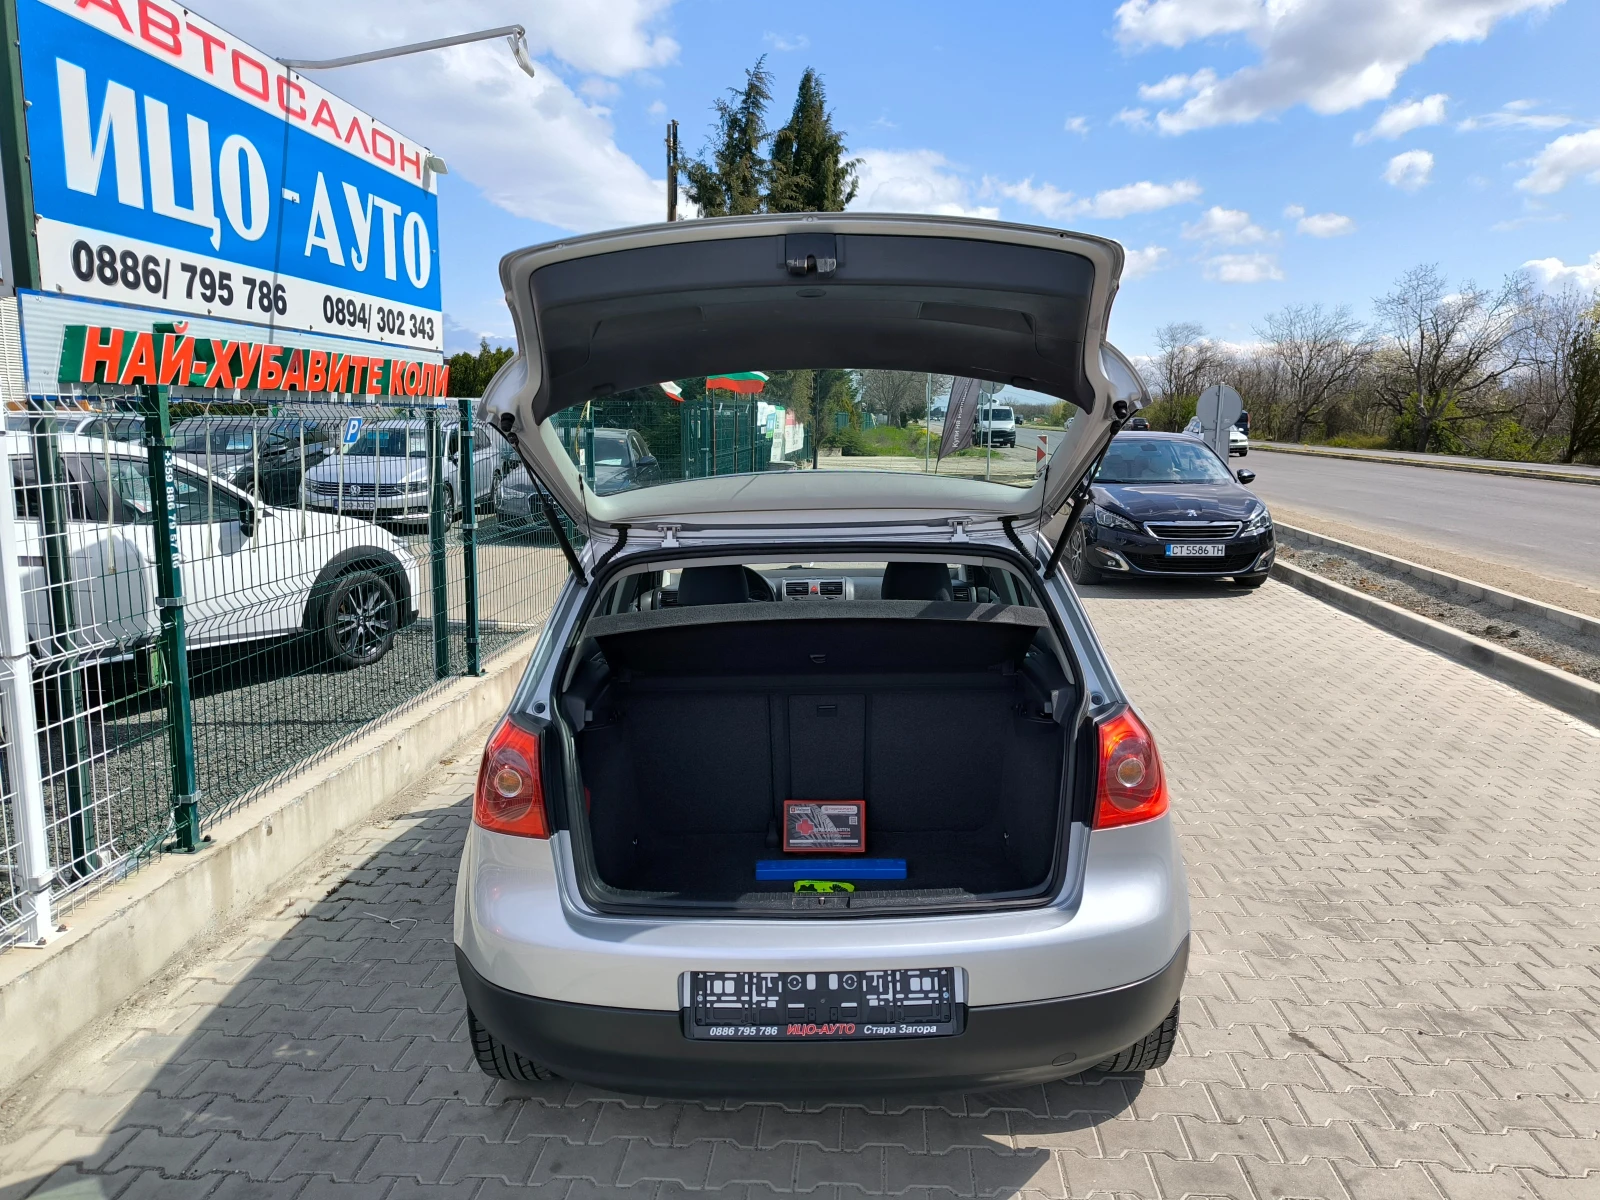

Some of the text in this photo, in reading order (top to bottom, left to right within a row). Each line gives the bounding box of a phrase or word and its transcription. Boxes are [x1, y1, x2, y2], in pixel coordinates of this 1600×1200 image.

[74, 0, 422, 180] АВТОСАЛОН
[55, 56, 432, 290] ИЦО-АУТО
[70, 239, 435, 341] 0886/ 795 786 0894/ 302 343
[79, 320, 450, 398] НАЙ-ХУБАВИТЕ КОЛИ
[164, 450, 174, 482] +359
[166, 486, 176, 511] 886
[168, 512, 177, 530] 79
[1172, 545, 1224, 555] CT 5586 TH
[709, 1023, 937, 1036] 0886 795 786 ИЦО-АУТО Стара Загора
